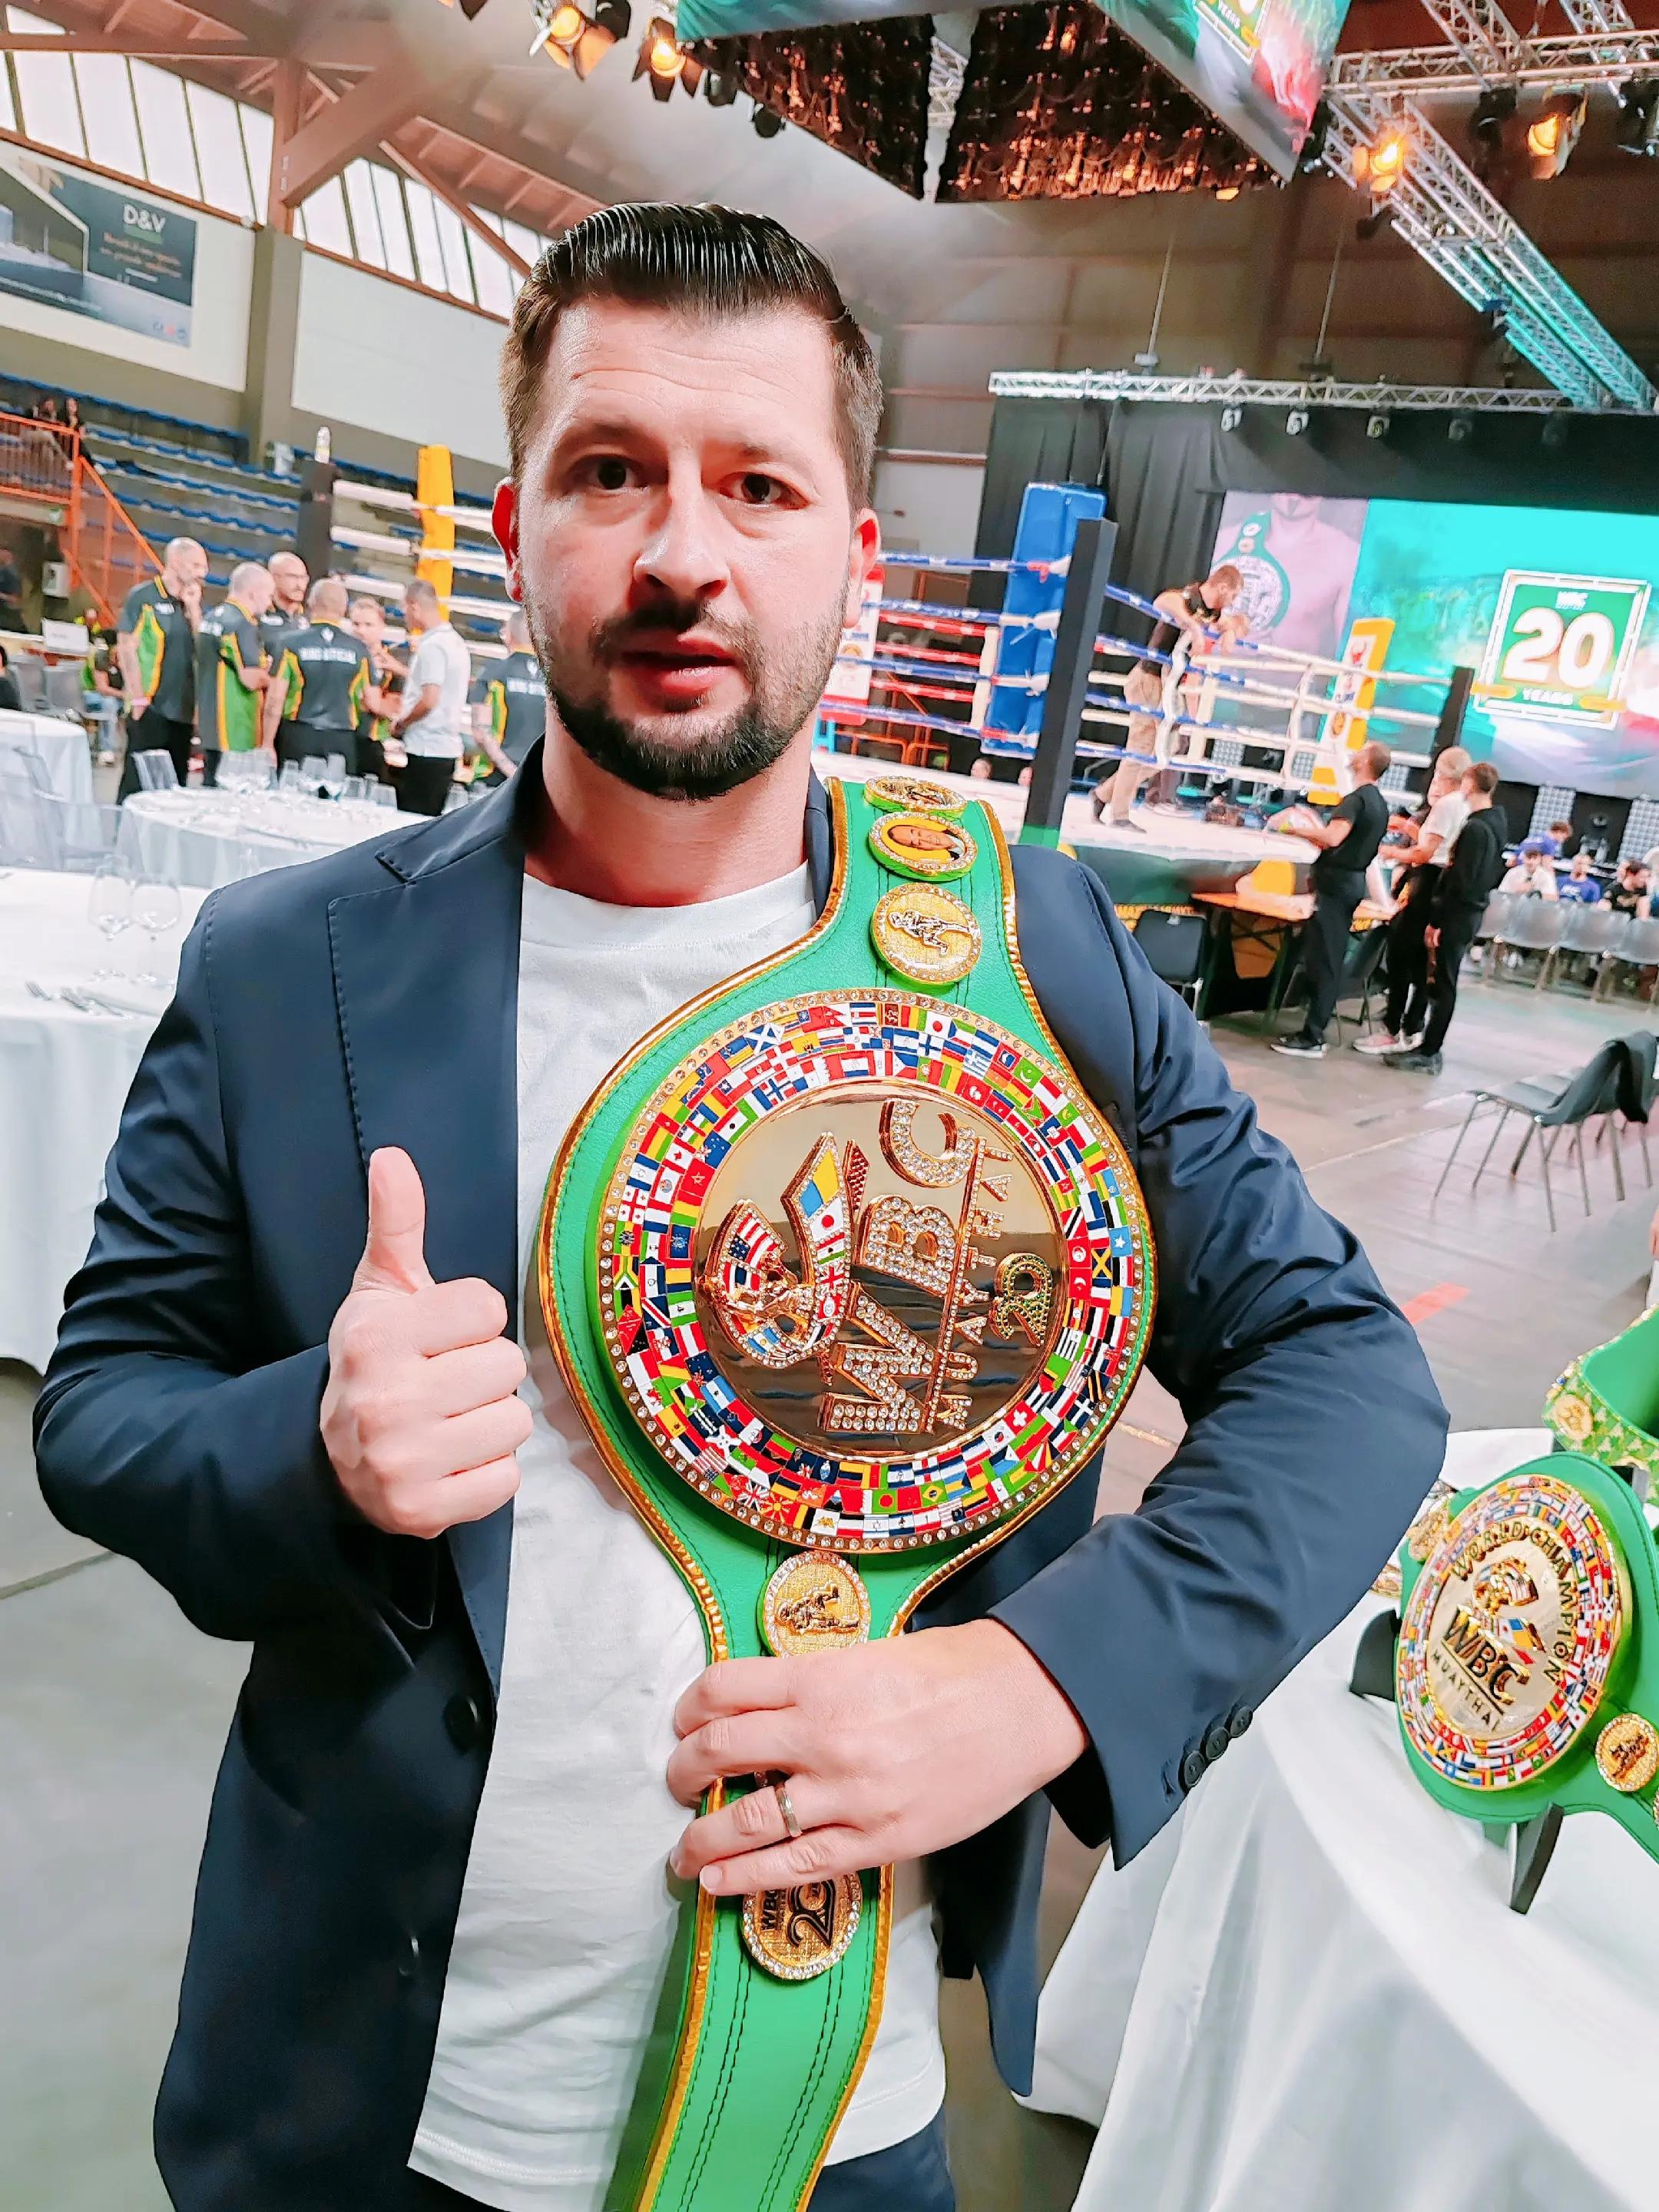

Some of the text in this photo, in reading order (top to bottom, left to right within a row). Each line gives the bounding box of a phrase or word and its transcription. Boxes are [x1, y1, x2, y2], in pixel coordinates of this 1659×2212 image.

[124, 203, 166, 233] D&V
[1502, 606, 1614, 688] 20
[1522, 687, 1573, 705] YEARS
[819, 1098, 977, 1433] WBC
[936, 1146, 1015, 1431] MUAYTHAI
[988, 1252, 1053, 1348] 20
[1452, 1521, 1579, 1687] WORLD CHAMPION
[1432, 1651, 1501, 1732] MUAYTHAI
[1443, 1604, 1531, 1706] WBC
